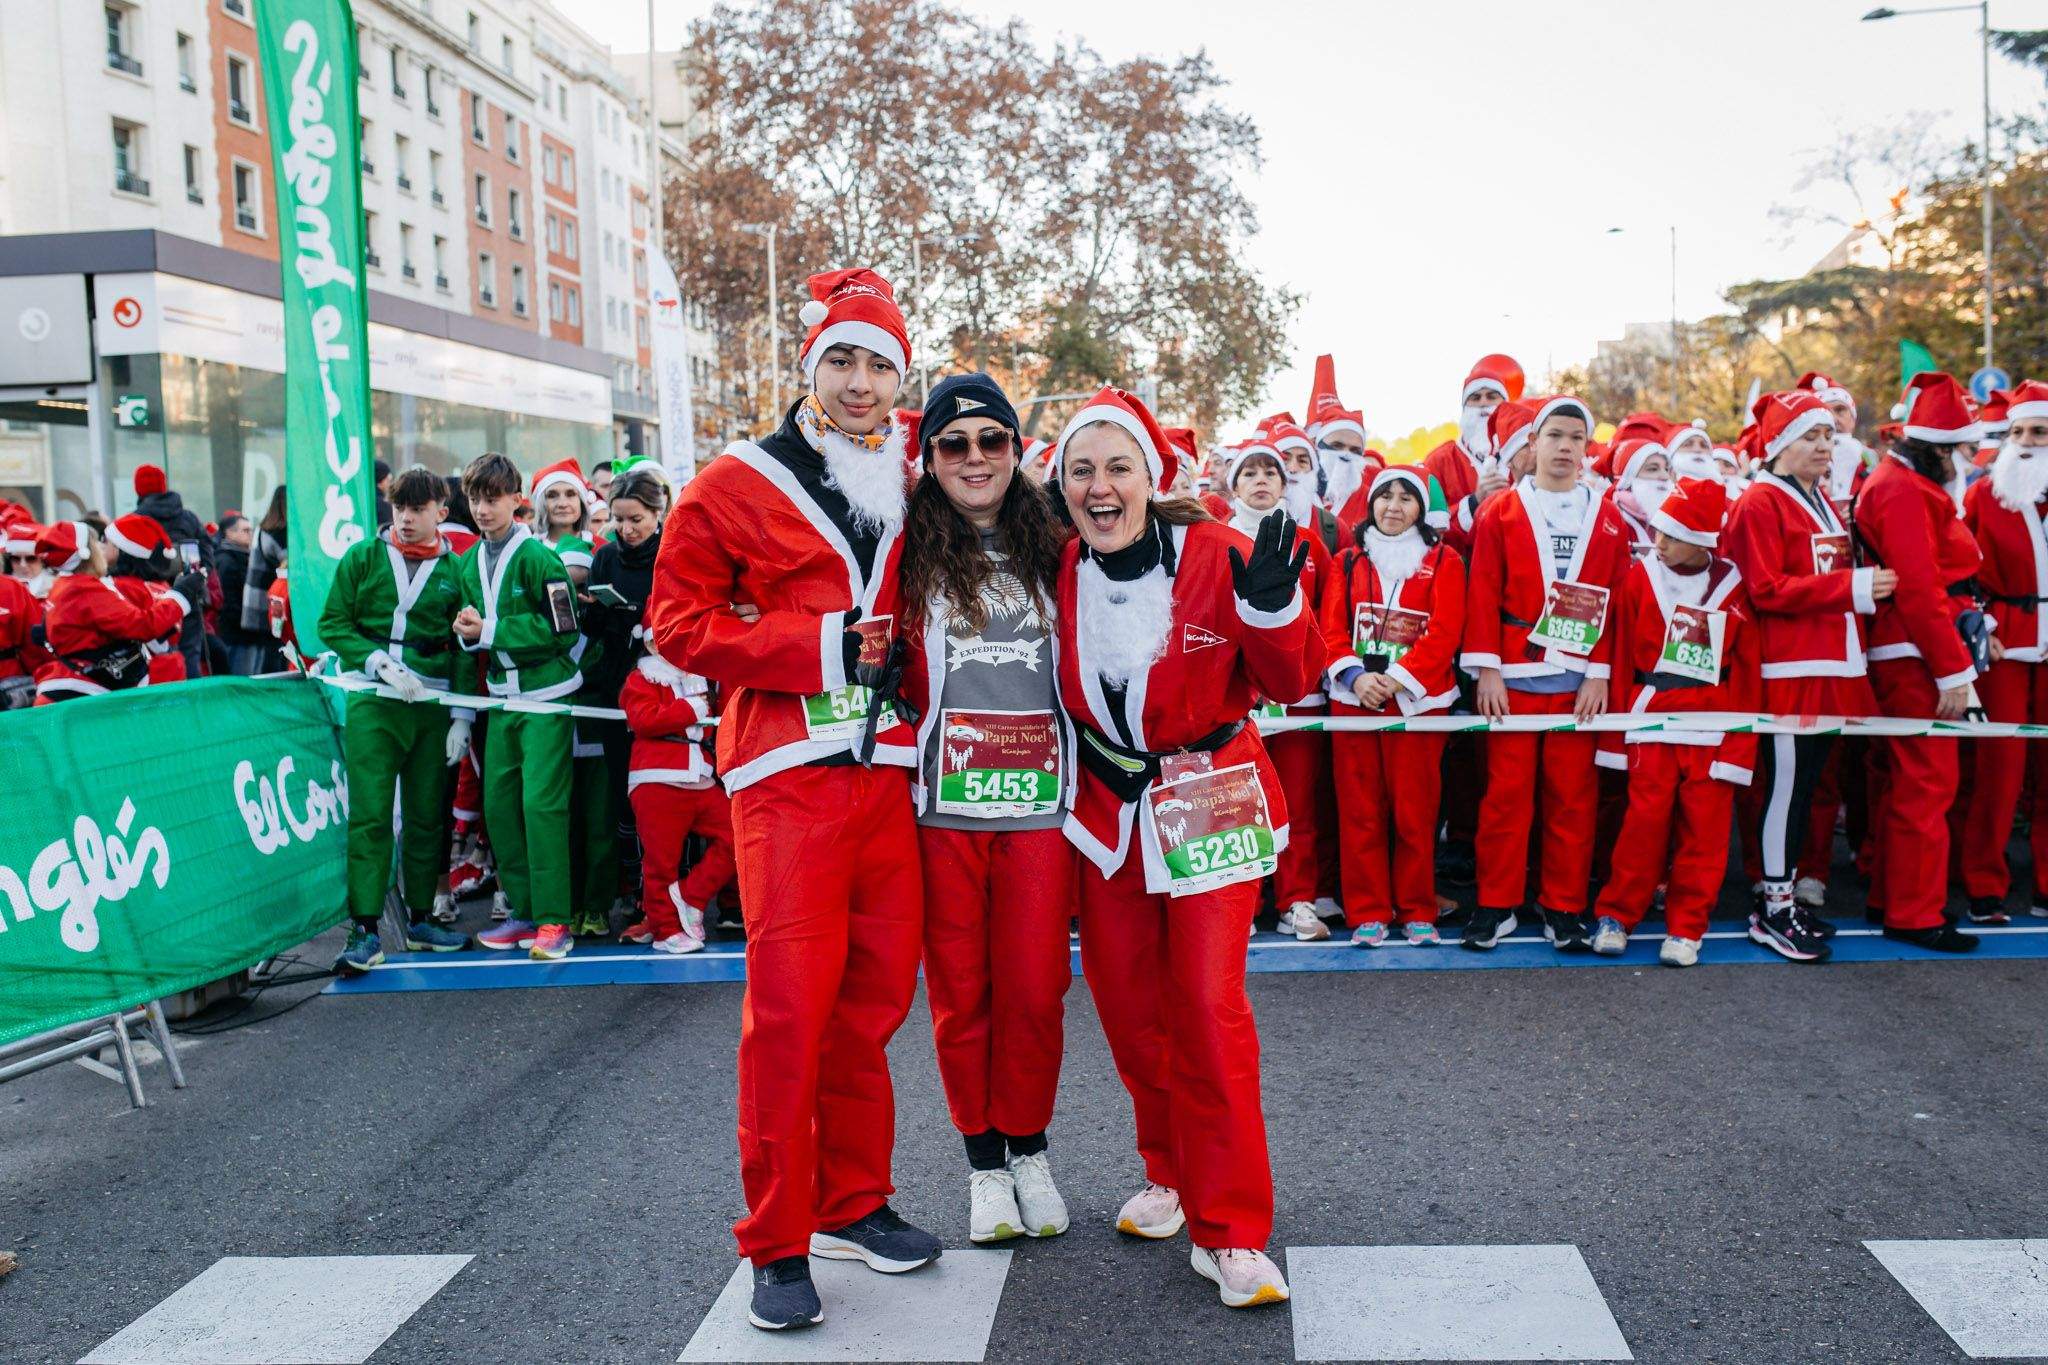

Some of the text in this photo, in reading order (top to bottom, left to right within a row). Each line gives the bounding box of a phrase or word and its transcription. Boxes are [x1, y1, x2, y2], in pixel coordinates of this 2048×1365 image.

[1547, 616, 1587, 642] 6365
[960, 645, 1015, 658] EXPEDITION
[985, 730, 1047, 746] Papá Noel
[964, 771, 1039, 802] 5453
[233, 759, 291, 855] El
[1192, 790, 1226, 810] Papá
[1186, 828, 1259, 873] 5230
